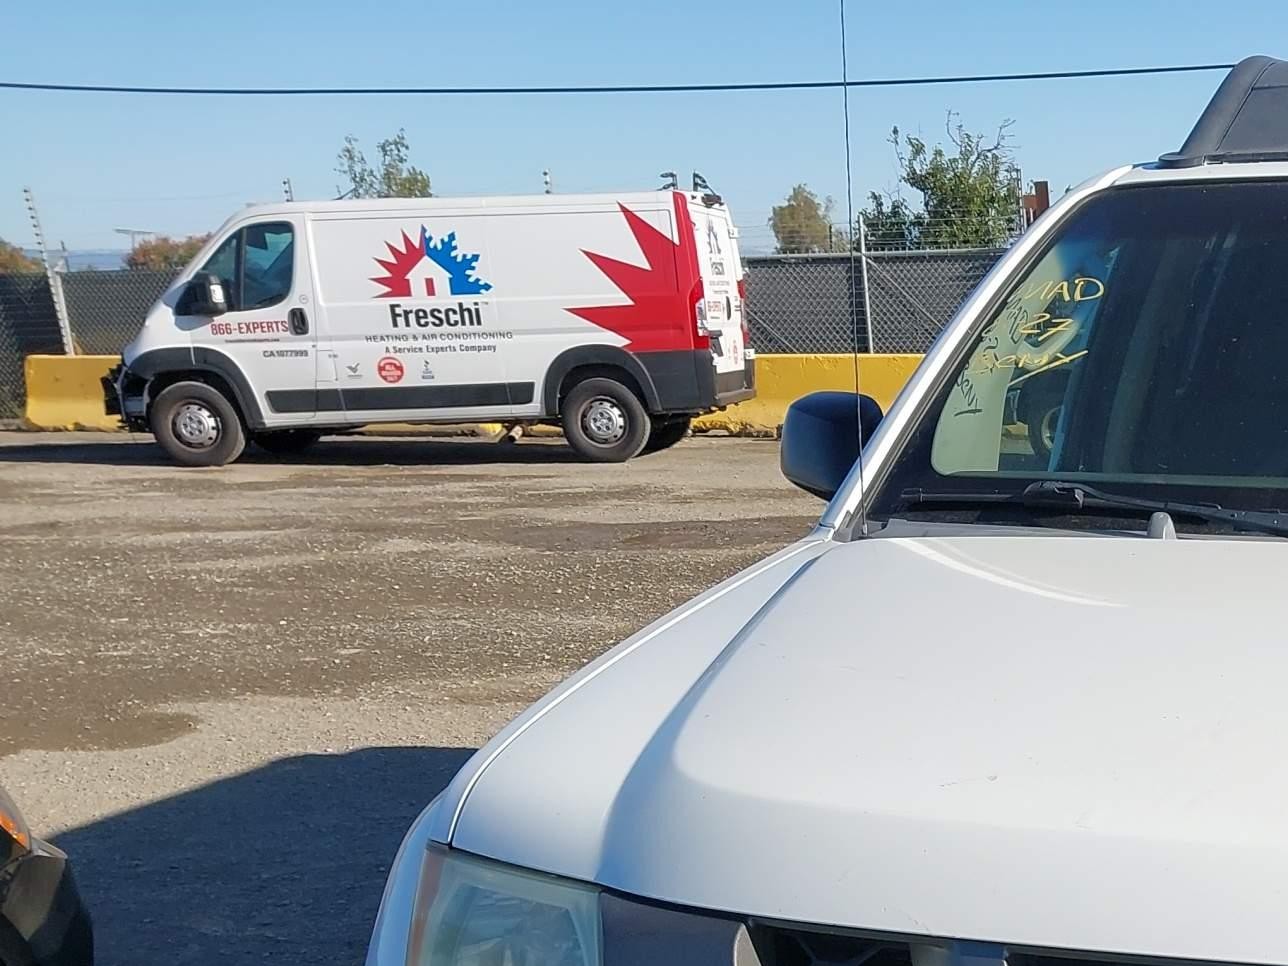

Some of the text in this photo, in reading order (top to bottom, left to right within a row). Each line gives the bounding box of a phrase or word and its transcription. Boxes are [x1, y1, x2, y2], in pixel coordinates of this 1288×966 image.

[389, 302, 482, 328] Freschi
[210, 320, 288, 336] 866-EXPERTS
[365, 334, 409, 343] HEATING
[421, 333, 437, 341] AIR
[440, 331, 513, 341] CONDITIONING
[392, 345, 424, 354] Service
[426, 344, 457, 354] Experts
[459, 343, 497, 353] Company
